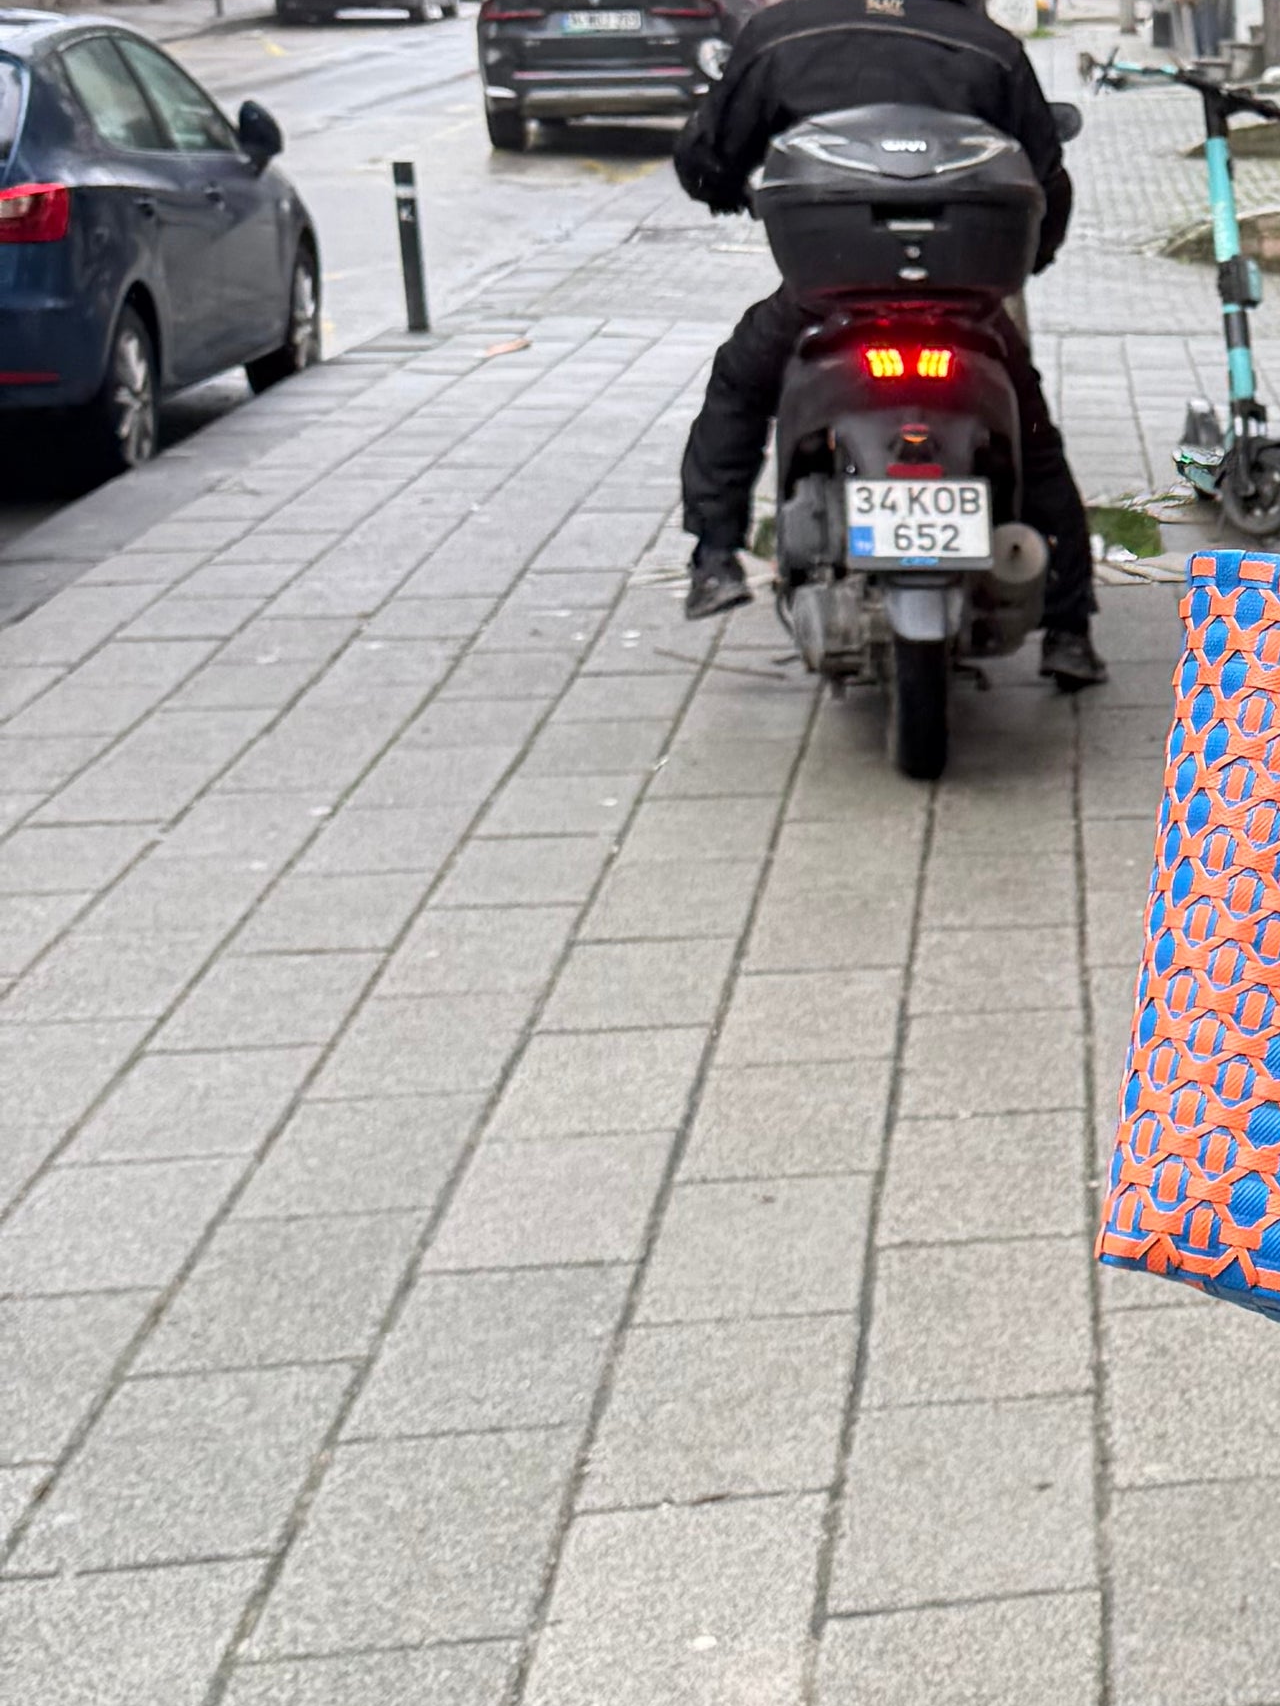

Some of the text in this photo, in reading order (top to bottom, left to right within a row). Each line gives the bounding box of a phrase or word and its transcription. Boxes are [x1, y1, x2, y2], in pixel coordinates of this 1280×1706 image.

[856, 486, 981, 515] 34 KOB
[893, 523, 961, 552] 652
